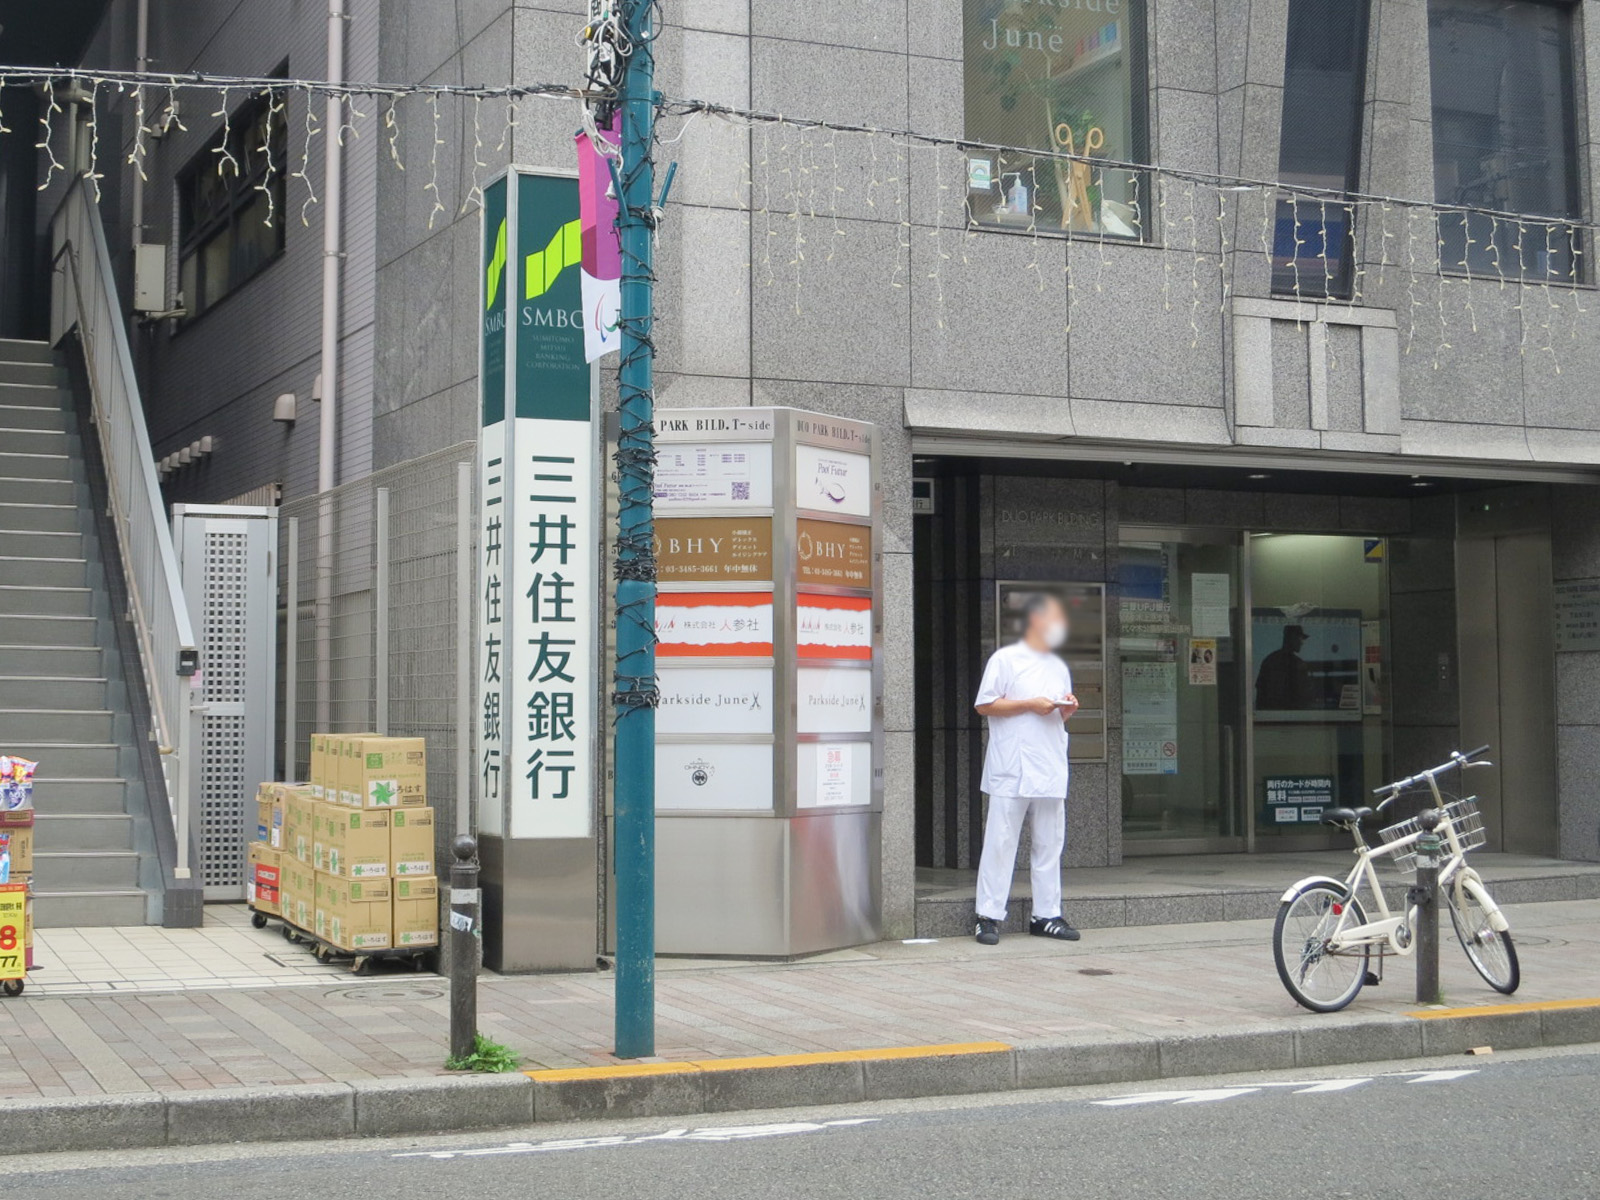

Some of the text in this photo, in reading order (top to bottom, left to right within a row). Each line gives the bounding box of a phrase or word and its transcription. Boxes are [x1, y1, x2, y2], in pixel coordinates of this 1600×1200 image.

[982, 18, 1064, 53] June
[660, 420, 689, 431] PARK
[723, 563, 759, 574] 年中無休
[484, 457, 502, 799] 三井住友銀行
[526, 455, 576, 800] 三井住友銀行
[683, 620, 717, 630] 株式会社
[656, 693, 750, 708] arkside June
[808, 694, 841, 707] Parkside
[841, 694, 860, 709] June
[1267, 790, 1287, 802] 無料
